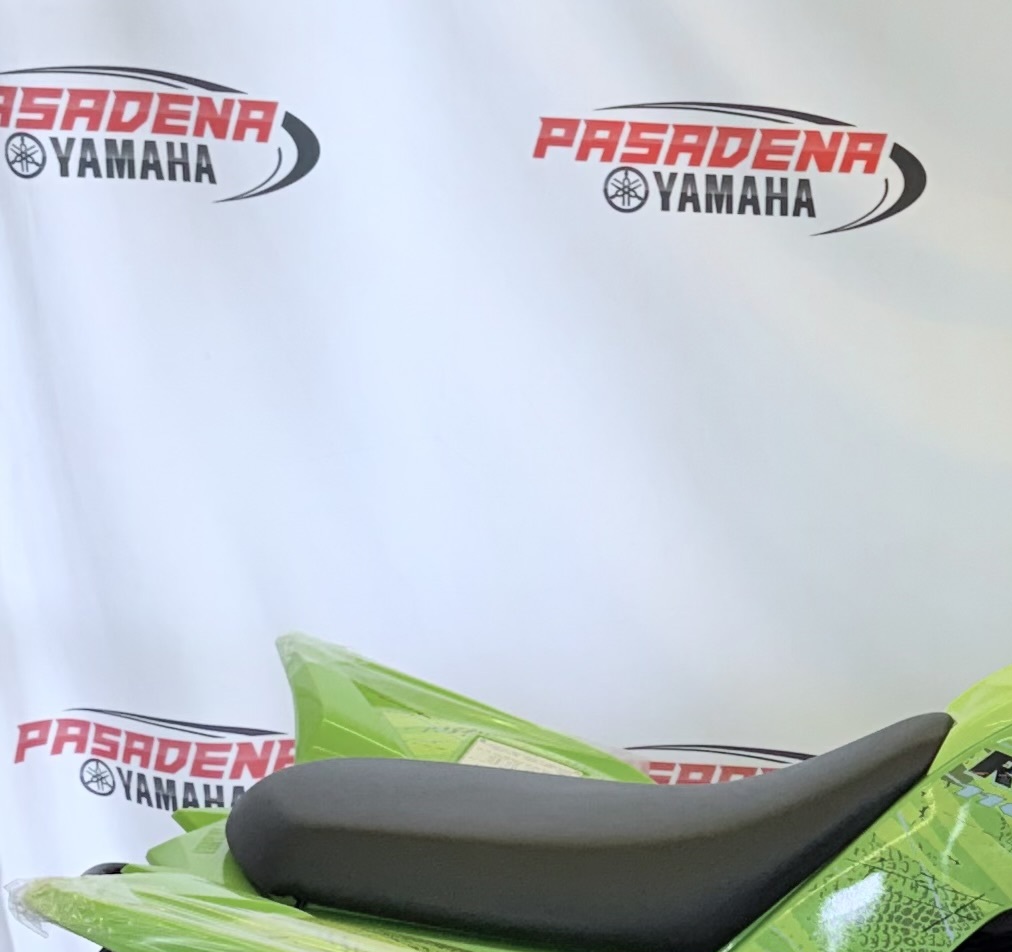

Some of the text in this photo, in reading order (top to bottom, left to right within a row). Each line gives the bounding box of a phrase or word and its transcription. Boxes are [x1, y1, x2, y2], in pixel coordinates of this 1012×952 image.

[49, 136, 217, 185] YAMAHA
[532, 117, 888, 174] PASADENA
[653, 171, 817, 218] YAMAHA
